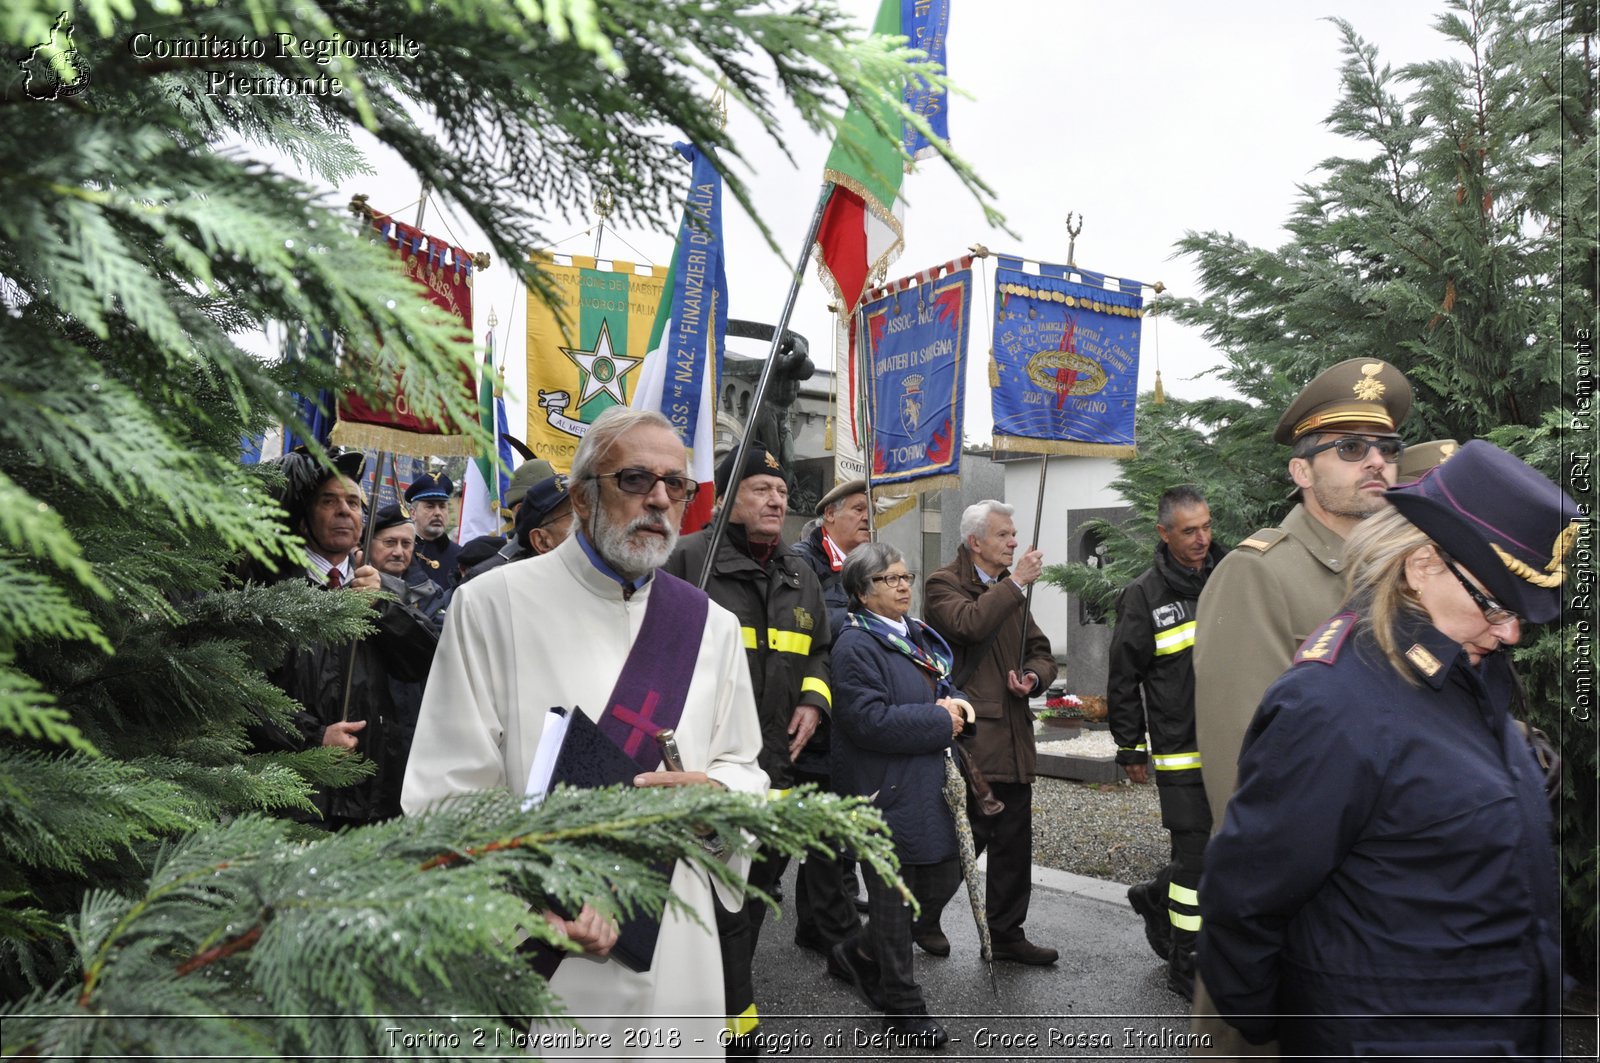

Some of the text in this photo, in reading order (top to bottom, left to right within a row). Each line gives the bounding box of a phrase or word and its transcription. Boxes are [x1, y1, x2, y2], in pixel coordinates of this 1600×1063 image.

[628, 282, 664, 296] MAESTR
[681, 249, 707, 334] FINANZIERI
[675, 347, 696, 383] NAZ.
[556, 420, 566, 429] AL
[536, 442, 575, 457] CONSO
